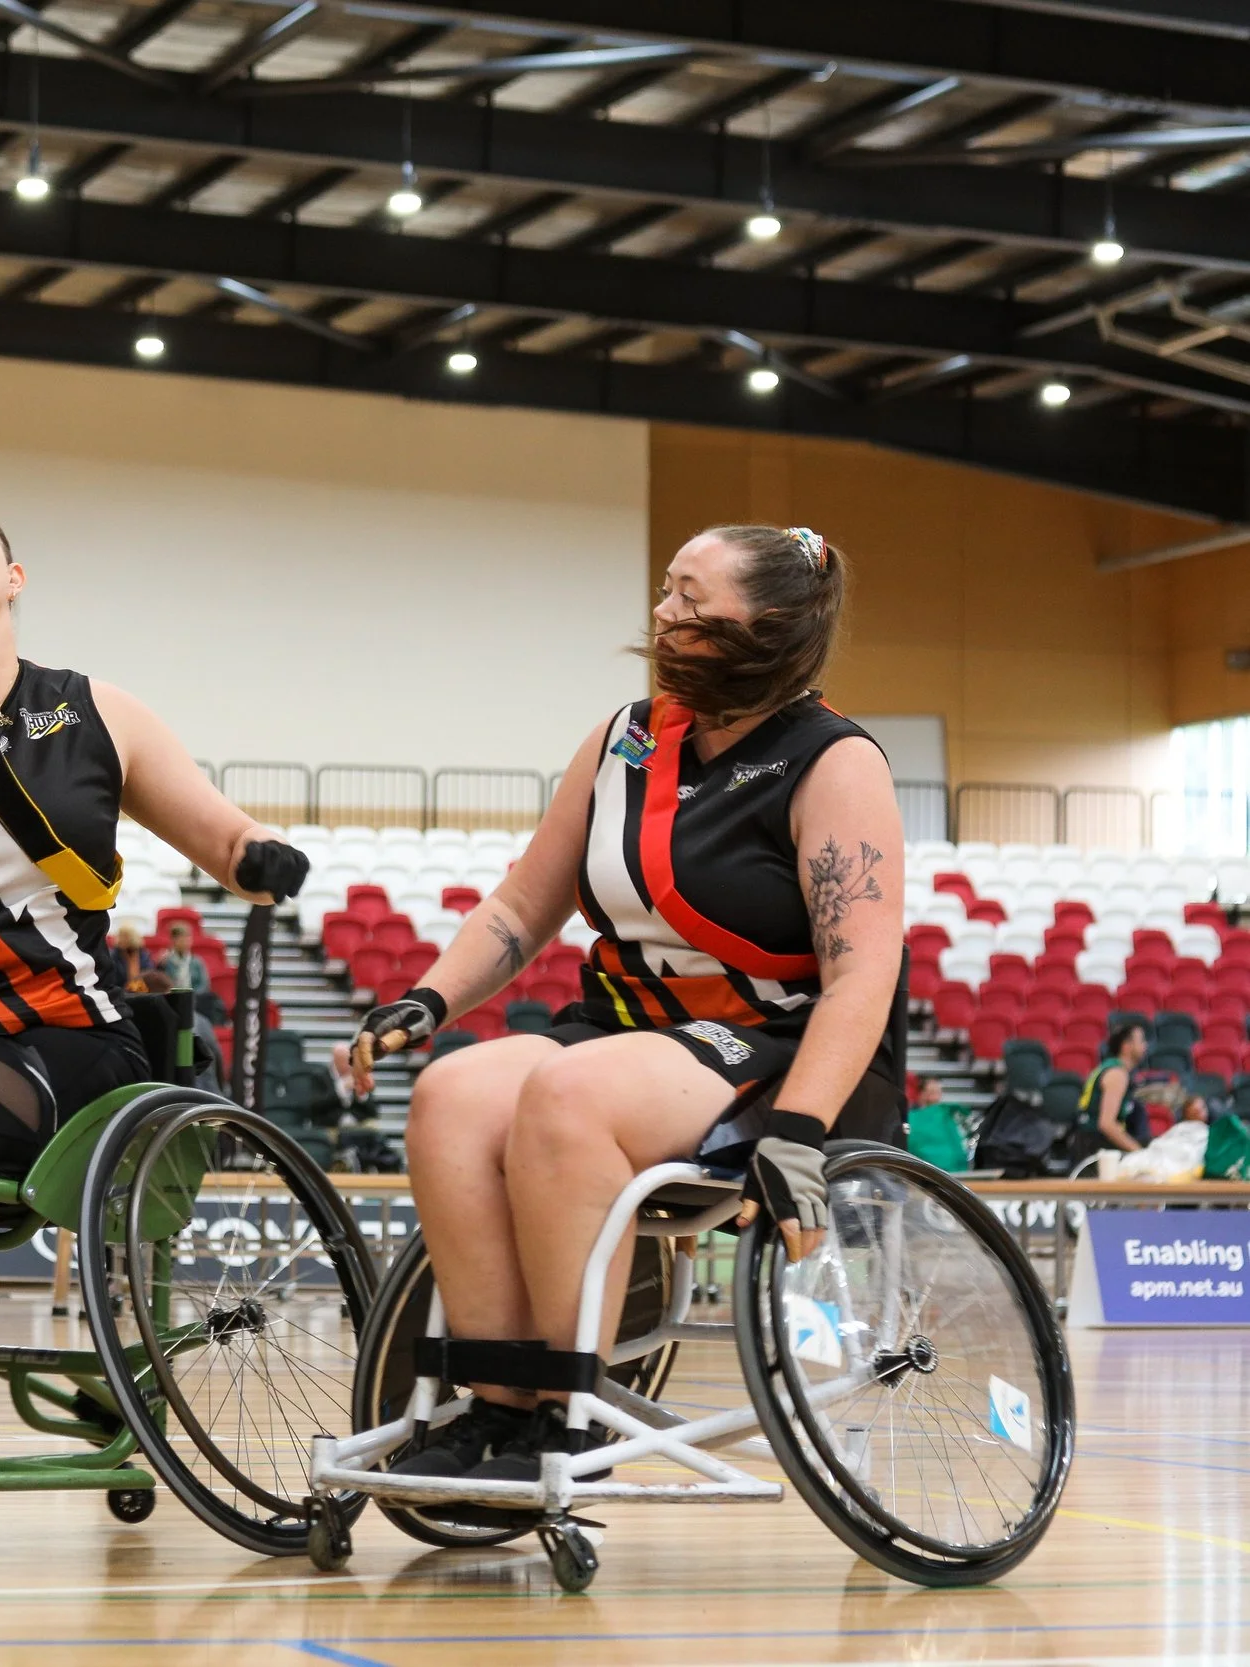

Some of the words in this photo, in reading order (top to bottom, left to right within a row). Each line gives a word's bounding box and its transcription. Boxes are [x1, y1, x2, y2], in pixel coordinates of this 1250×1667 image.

[628, 724, 649, 742] AFL
[1124, 1239, 1244, 1271] Enabling
[1130, 1278, 1244, 1302] apm.net.au
